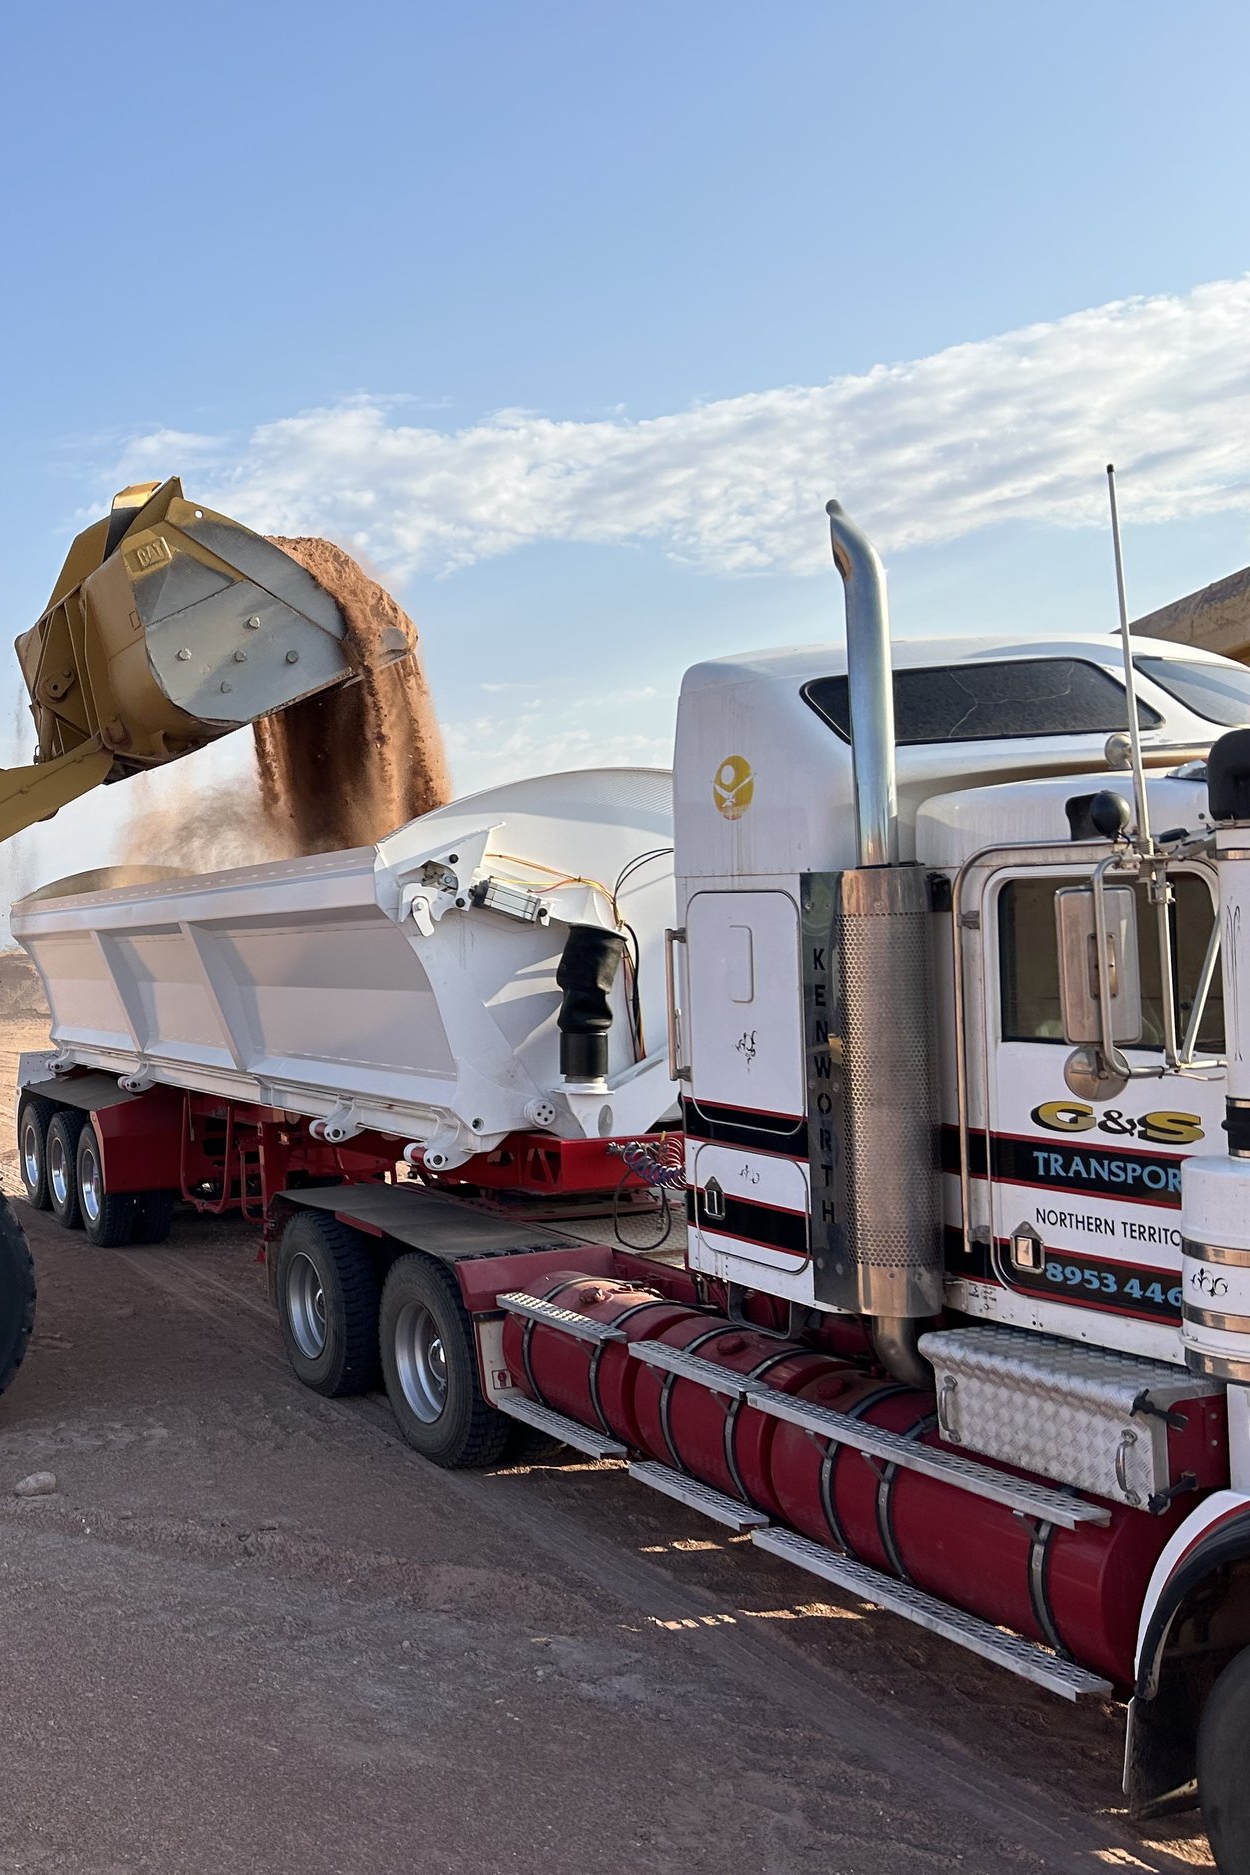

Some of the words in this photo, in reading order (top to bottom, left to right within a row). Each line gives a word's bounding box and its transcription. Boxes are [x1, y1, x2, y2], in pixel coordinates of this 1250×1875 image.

[137, 541, 166, 567] CAT
[813, 948, 836, 1224] KENWORTH
[1031, 1101, 1205, 1145] G&S
[1036, 1208, 1115, 1236] NORTHERN
[1045, 1263, 1118, 1293] 8953
